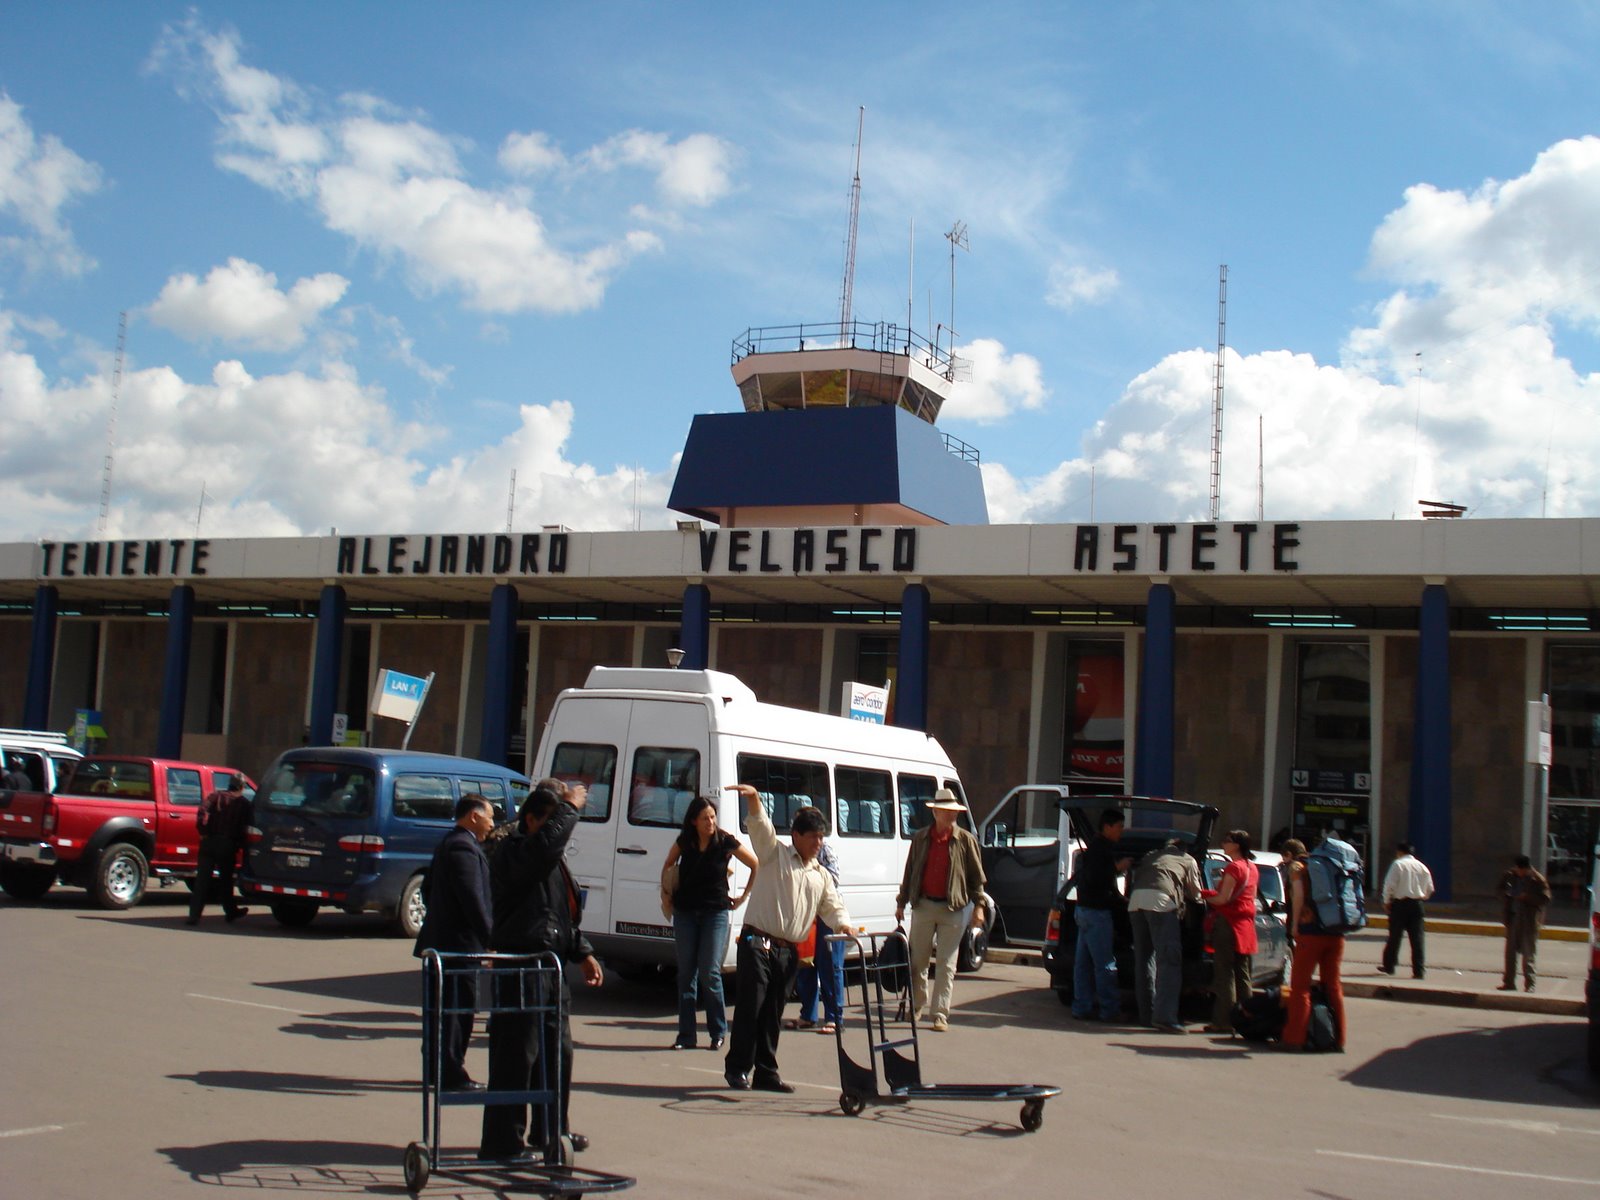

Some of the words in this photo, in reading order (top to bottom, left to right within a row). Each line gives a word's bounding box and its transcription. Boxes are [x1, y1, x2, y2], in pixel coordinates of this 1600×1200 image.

[41, 540, 210, 577] TENIENTE
[336, 534, 569, 575] ALEJANDRO
[699, 527, 917, 574] VELASCO
[1073, 523, 1301, 573] ASTETE
[391, 680, 409, 692] LAN
[853, 695, 865, 706] aero
[1358, 775, 1367, 787] 3
